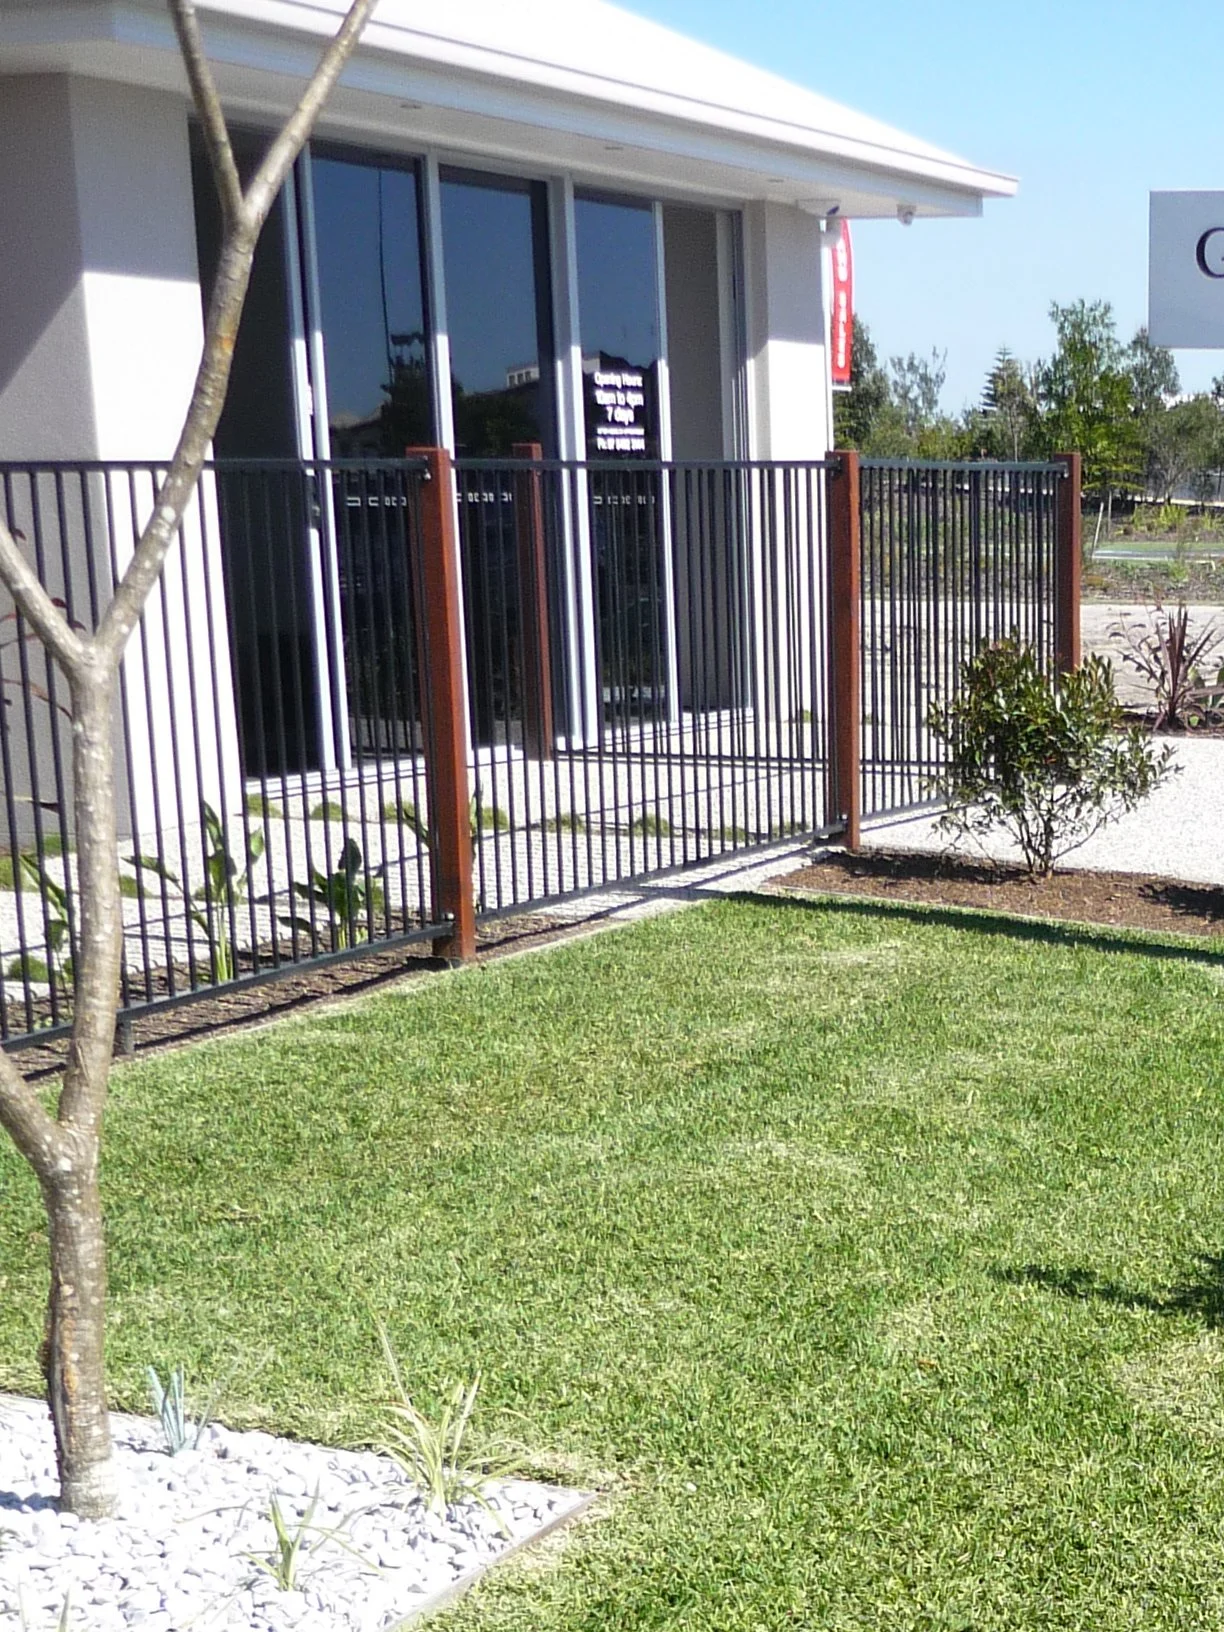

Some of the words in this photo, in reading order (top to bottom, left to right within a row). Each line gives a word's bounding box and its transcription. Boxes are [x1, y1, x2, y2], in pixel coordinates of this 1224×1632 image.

[594, 372, 621, 389] Opening
[617, 390, 626, 405] to
[606, 406, 613, 422] 7
[614, 406, 634, 426] days
